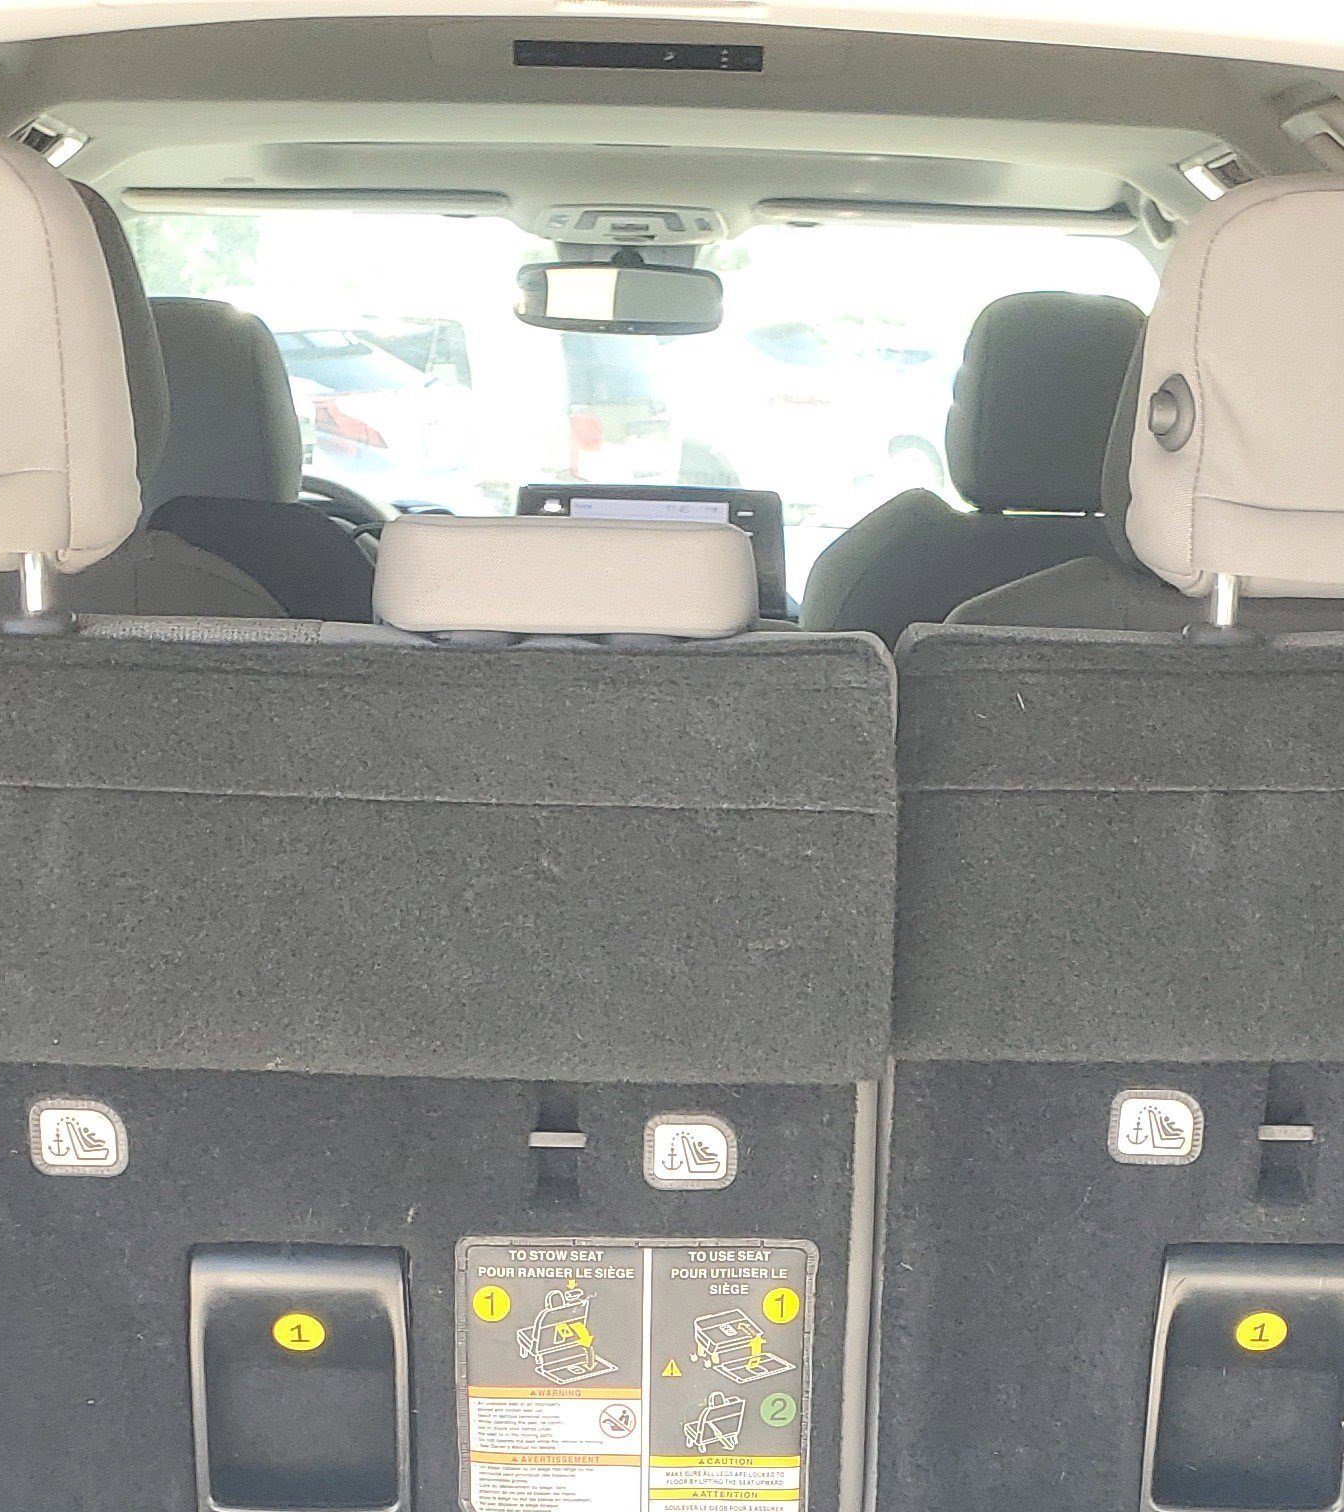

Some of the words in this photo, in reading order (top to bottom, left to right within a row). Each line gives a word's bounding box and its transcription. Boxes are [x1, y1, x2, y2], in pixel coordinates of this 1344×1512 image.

[509, 1250, 527, 1261] TO
[529, 1250, 568, 1261] STOW
[570, 1250, 604, 1261] SEAT
[688, 1251, 706, 1262] TO
[709, 1251, 736, 1262] USE
[737, 1251, 772, 1262] SEAT
[478, 1266, 514, 1278] POUR
[518, 1267, 573, 1278] RANGER
[576, 1267, 593, 1278] LE
[595, 1265, 635, 1279] SIÈGE
[671, 1268, 707, 1279] POUR
[710, 1268, 768, 1279] UTILISER
[771, 1268, 788, 1279] LE
[709, 1281, 749, 1295] SIÈGE
[484, 1291, 495, 1316] 1
[774, 1293, 785, 1318] 1
[290, 1323, 310, 1343] 1
[1249, 1322, 1270, 1343] 1
[538, 1389, 581, 1397] WARNING
[770, 1397, 787, 1421] 2
[521, 1455, 600, 1464] AVERTISSEMENT
[706, 1458, 753, 1466] CAUTION
[700, 1491, 758, 1499] ATTENTION
